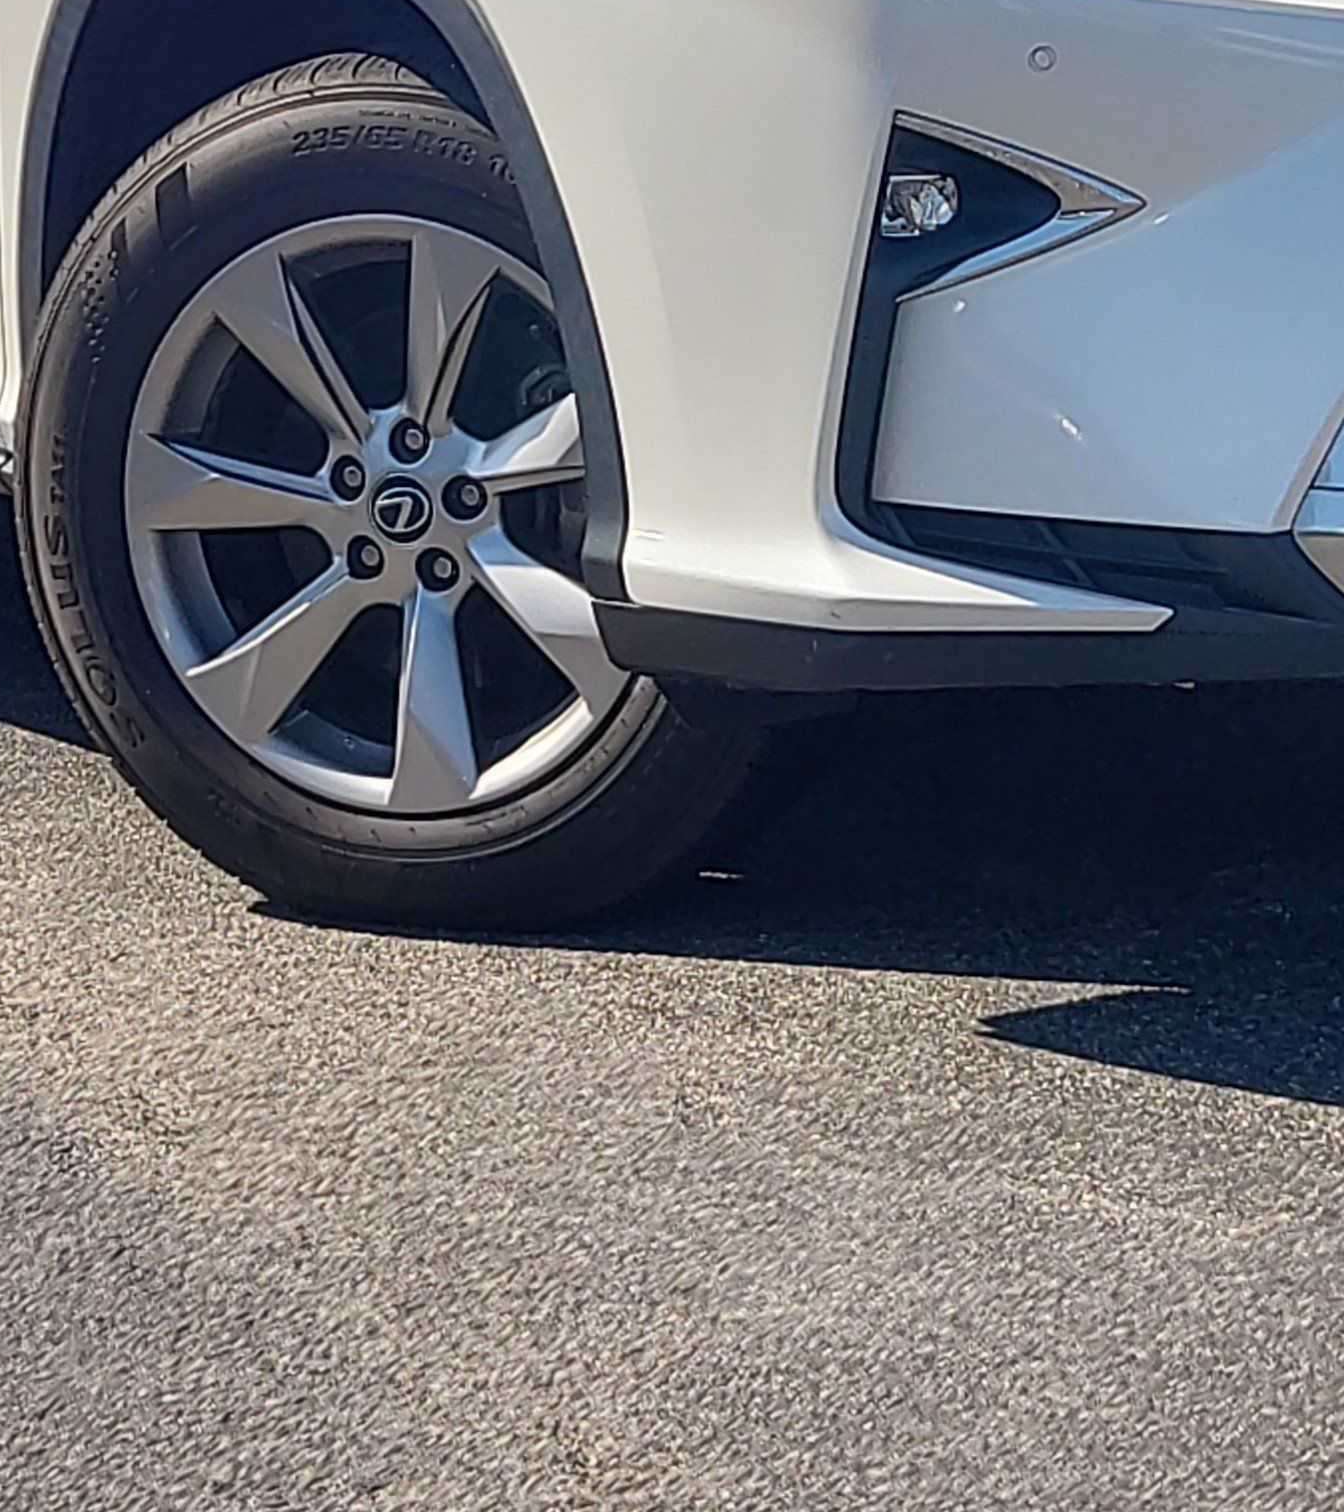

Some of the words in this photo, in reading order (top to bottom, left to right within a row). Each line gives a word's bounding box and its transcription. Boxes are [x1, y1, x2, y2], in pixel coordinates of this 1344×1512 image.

[291, 124, 408, 157] 235/65
[413, 129, 477, 166] R18
[44, 514, 145, 748] SOLUS
